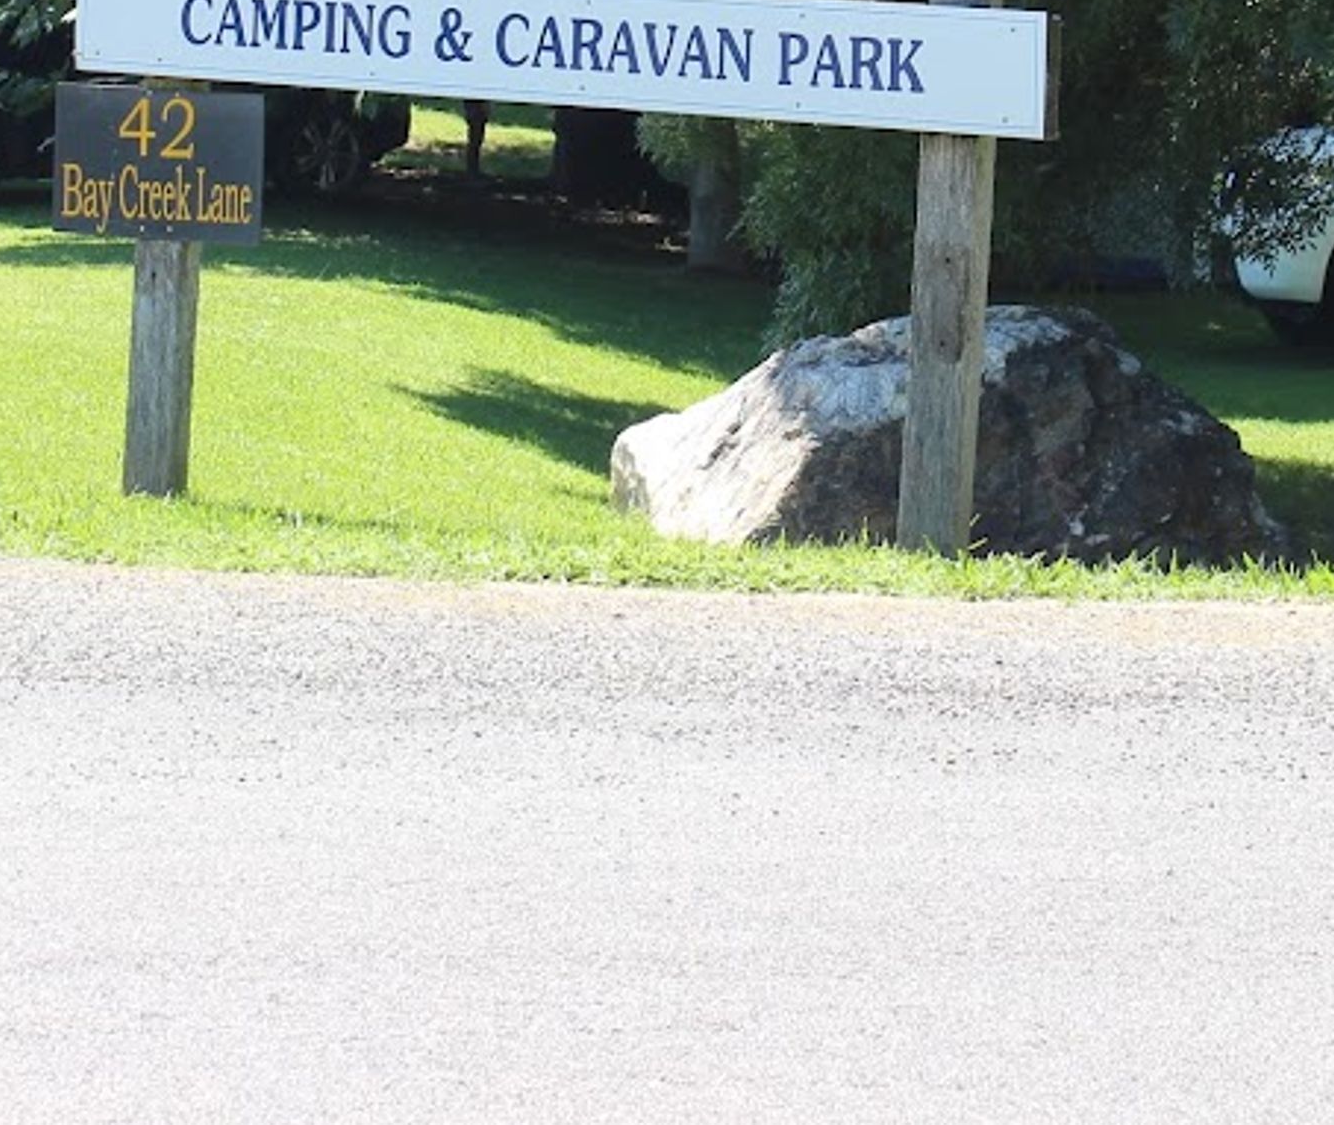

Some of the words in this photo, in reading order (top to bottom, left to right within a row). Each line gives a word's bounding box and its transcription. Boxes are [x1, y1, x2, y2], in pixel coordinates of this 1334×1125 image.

[433, 6, 473, 62] &
[495, 13, 754, 83] CARAVAN
[777, 31, 924, 93] PARK
[118, 97, 196, 159] 42
[61, 163, 114, 233] Bay
[119, 164, 191, 221] Creek
[196, 167, 252, 224] Lane
